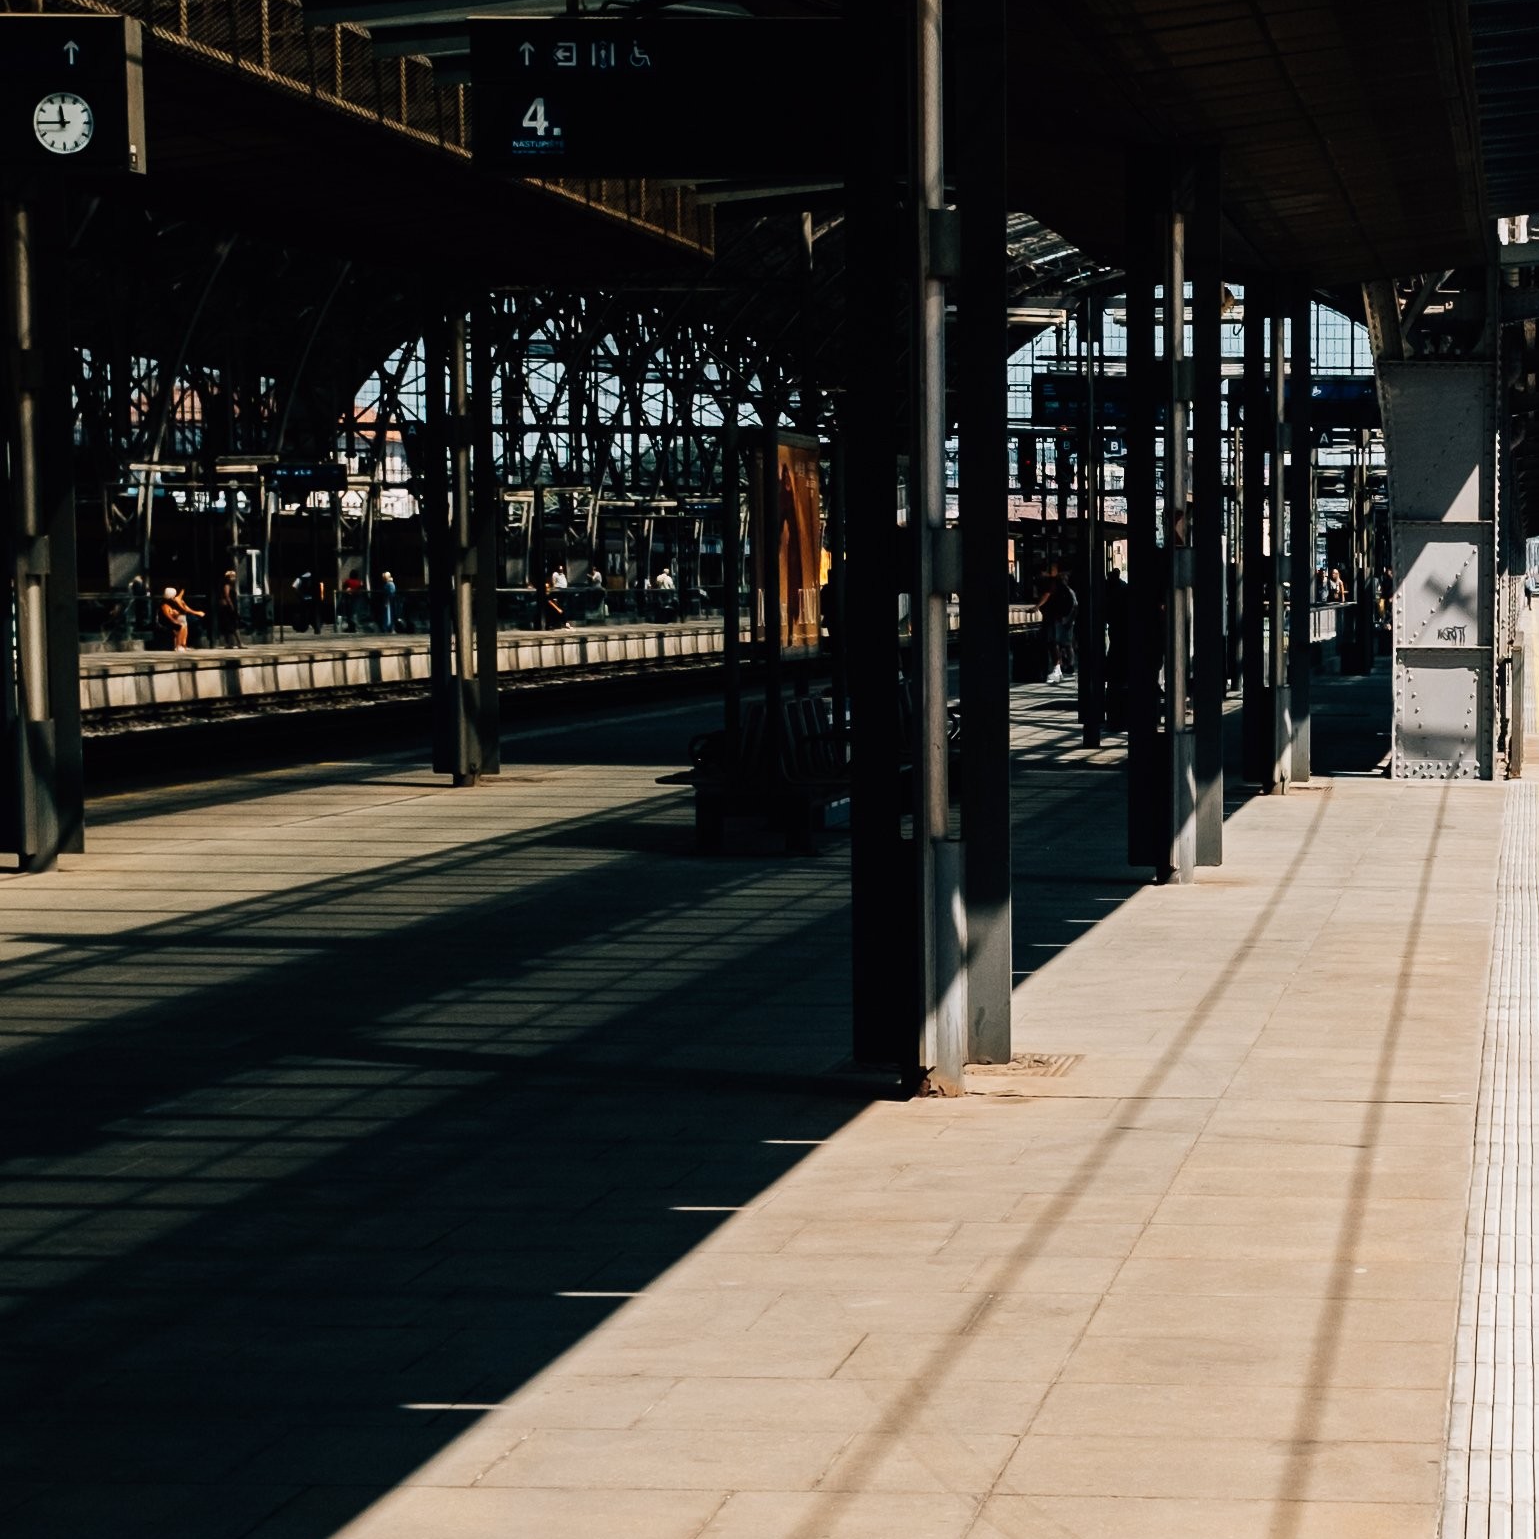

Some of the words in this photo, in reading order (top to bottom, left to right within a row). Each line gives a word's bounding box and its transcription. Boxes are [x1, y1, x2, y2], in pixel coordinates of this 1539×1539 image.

[522, 97, 562, 136] 4.
[1319, 432, 1329, 444] A
[1110, 441, 1119, 451] B
